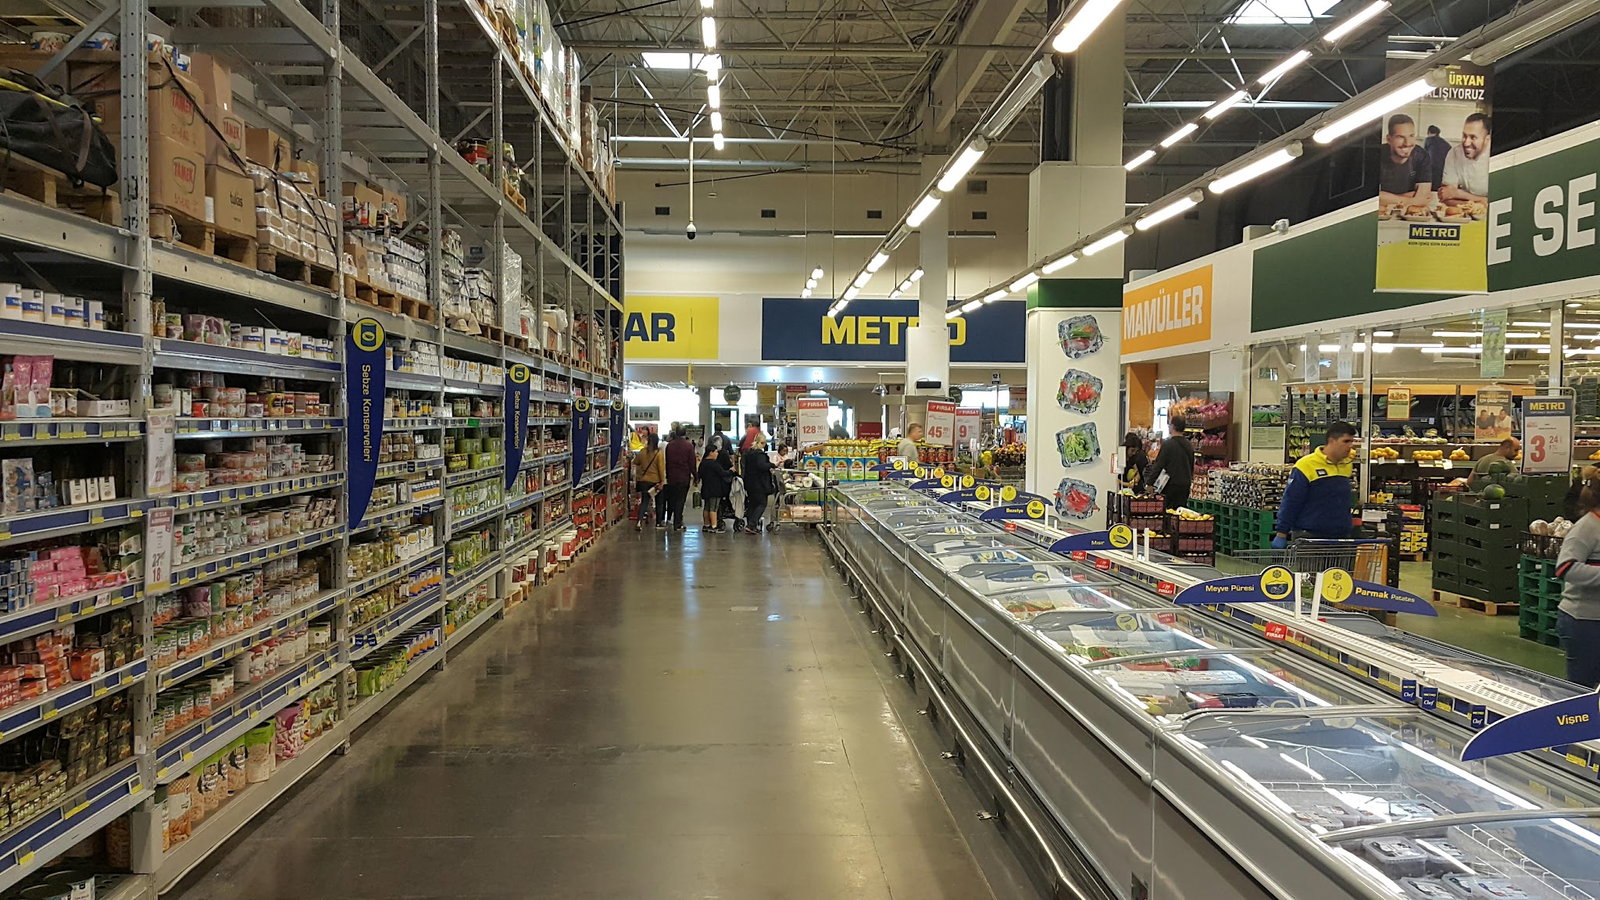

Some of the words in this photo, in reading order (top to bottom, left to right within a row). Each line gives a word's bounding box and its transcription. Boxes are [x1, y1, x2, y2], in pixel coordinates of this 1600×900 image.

[1411, 227, 1458, 238] METRO
[1123, 285, 1204, 341] MAMÜLLER
[362, 364, 371, 395] Sebze
[1529, 402, 1566, 411] METRO
[362, 398, 373, 462] Konserveleri
[802, 425, 816, 434] 128
[928, 425, 942, 438] 45
[959, 424, 967, 438] 9
[1530, 434, 1546, 463] 3
[1205, 585, 1229, 593] Meyve
[1355, 587, 1389, 599] Parmak
[1391, 594, 1416, 603] Patates
[1556, 713, 1590, 726] Vişne
